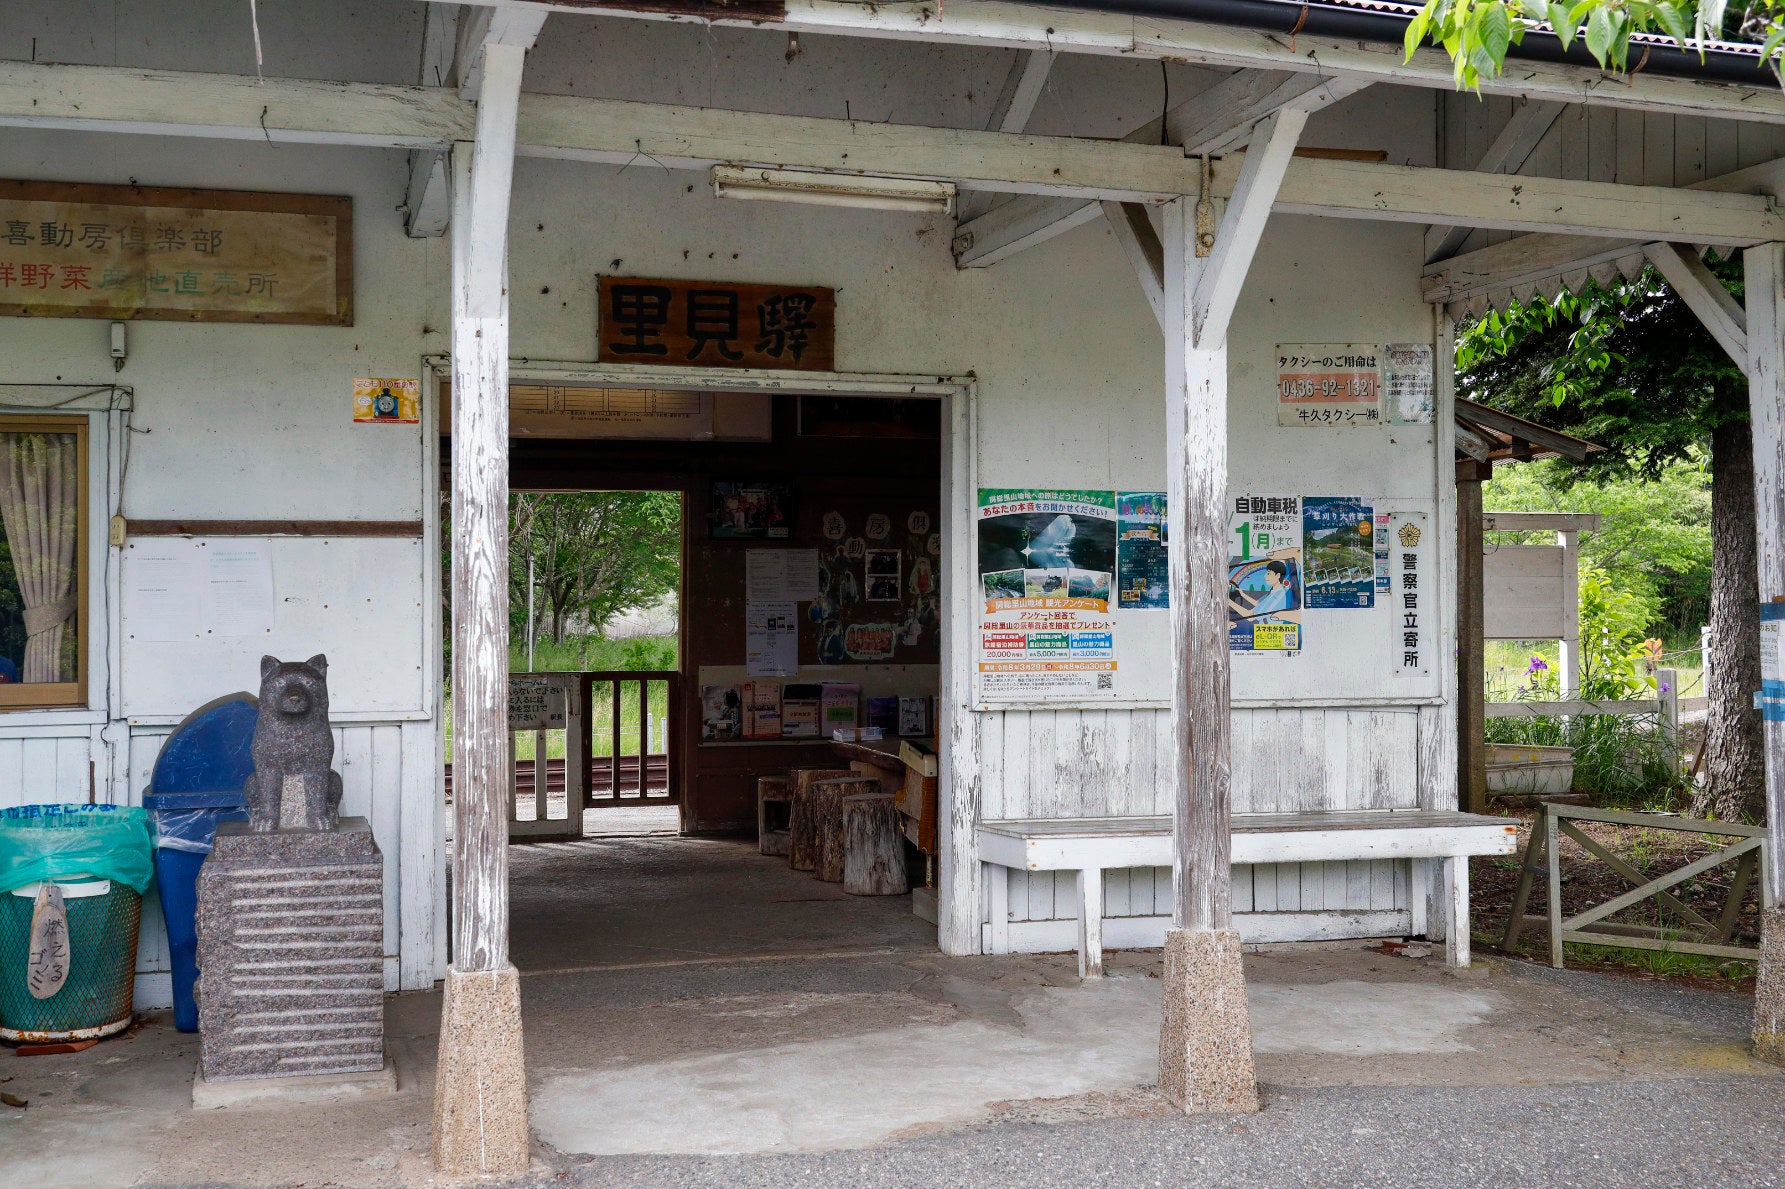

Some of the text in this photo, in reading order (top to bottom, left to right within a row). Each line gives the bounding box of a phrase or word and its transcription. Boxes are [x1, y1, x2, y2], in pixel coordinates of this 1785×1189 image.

[608, 284, 817, 361] 里見驛
[1278, 355, 1377, 368] タクシーのご用命は
[1282, 378, 1376, 398] 0436-92-1321
[1235, 496, 1298, 515] 自動車税
[1252, 523, 1290, 531] 納めましょう
[1019, 611, 1076, 620] アンケート回答で
[1403, 553, 1418, 668] 警察官立寄所
[1256, 625, 1296, 633] スマホがあれば
